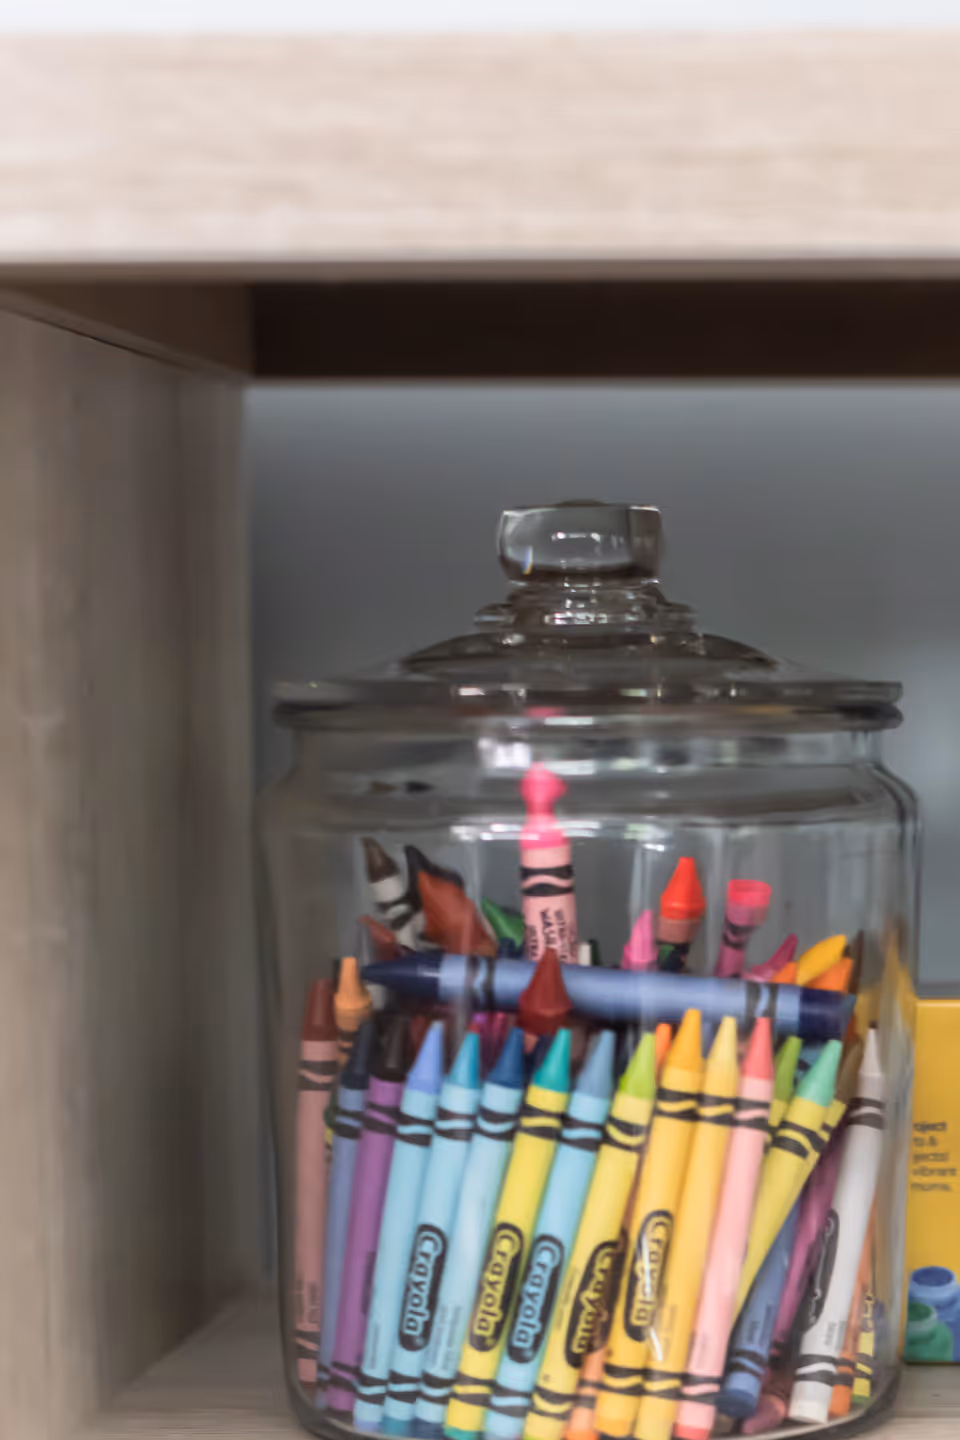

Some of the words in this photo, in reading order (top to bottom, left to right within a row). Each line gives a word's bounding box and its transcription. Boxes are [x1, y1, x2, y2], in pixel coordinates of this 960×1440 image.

[402, 1229, 441, 1336] Crayola
[474, 1230, 519, 1336] Crayola
[511, 1242, 562, 1347] Crayola
[630, 1215, 670, 1327] Crayola
